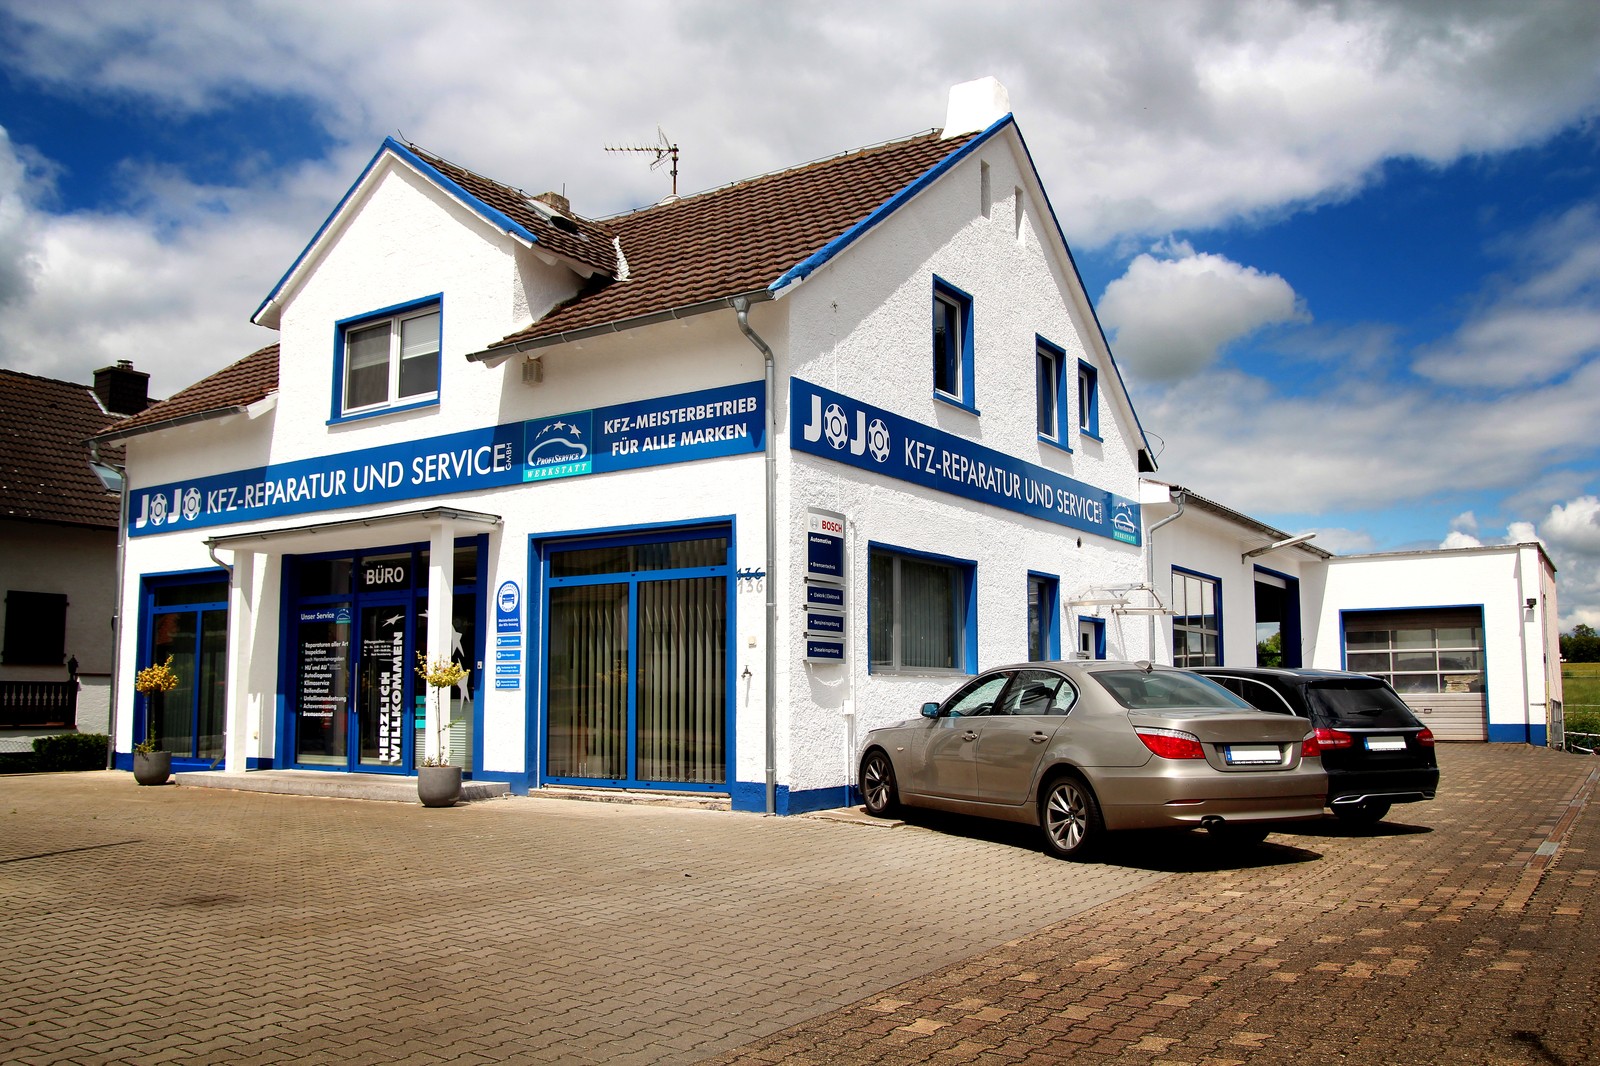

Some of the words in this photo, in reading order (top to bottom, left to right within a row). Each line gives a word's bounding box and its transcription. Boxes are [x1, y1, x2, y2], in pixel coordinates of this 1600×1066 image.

[604, 397, 757, 434] KFZ-MEISTERBETRIEB
[612, 437, 639, 457] FÜR
[642, 433, 676, 452] ALLE
[680, 423, 747, 446] MARKEN
[527, 463, 587, 478] WERKSTATT
[804, 394, 891, 463] JOJO
[905, 437, 1021, 500] KFZ-REPARATUR
[1025, 477, 1053, 509] UND
[1057, 488, 1100, 524] SERVICE
[136, 487, 202, 529] JOJO
[207, 469, 347, 514] KFZ-REPARATUR
[353, 461, 404, 493] UND
[411, 443, 506, 485] SERVICE
[821, 520, 843, 533] BOSCH
[810, 536, 832, 545] Automotive
[366, 566, 404, 585] BÜRO
[316, 611, 335, 619] Service
[305, 642, 330, 650] Reparaturen
[391, 631, 403, 763] WILLKOMMEN
[379, 672, 391, 761] HERZLICH
